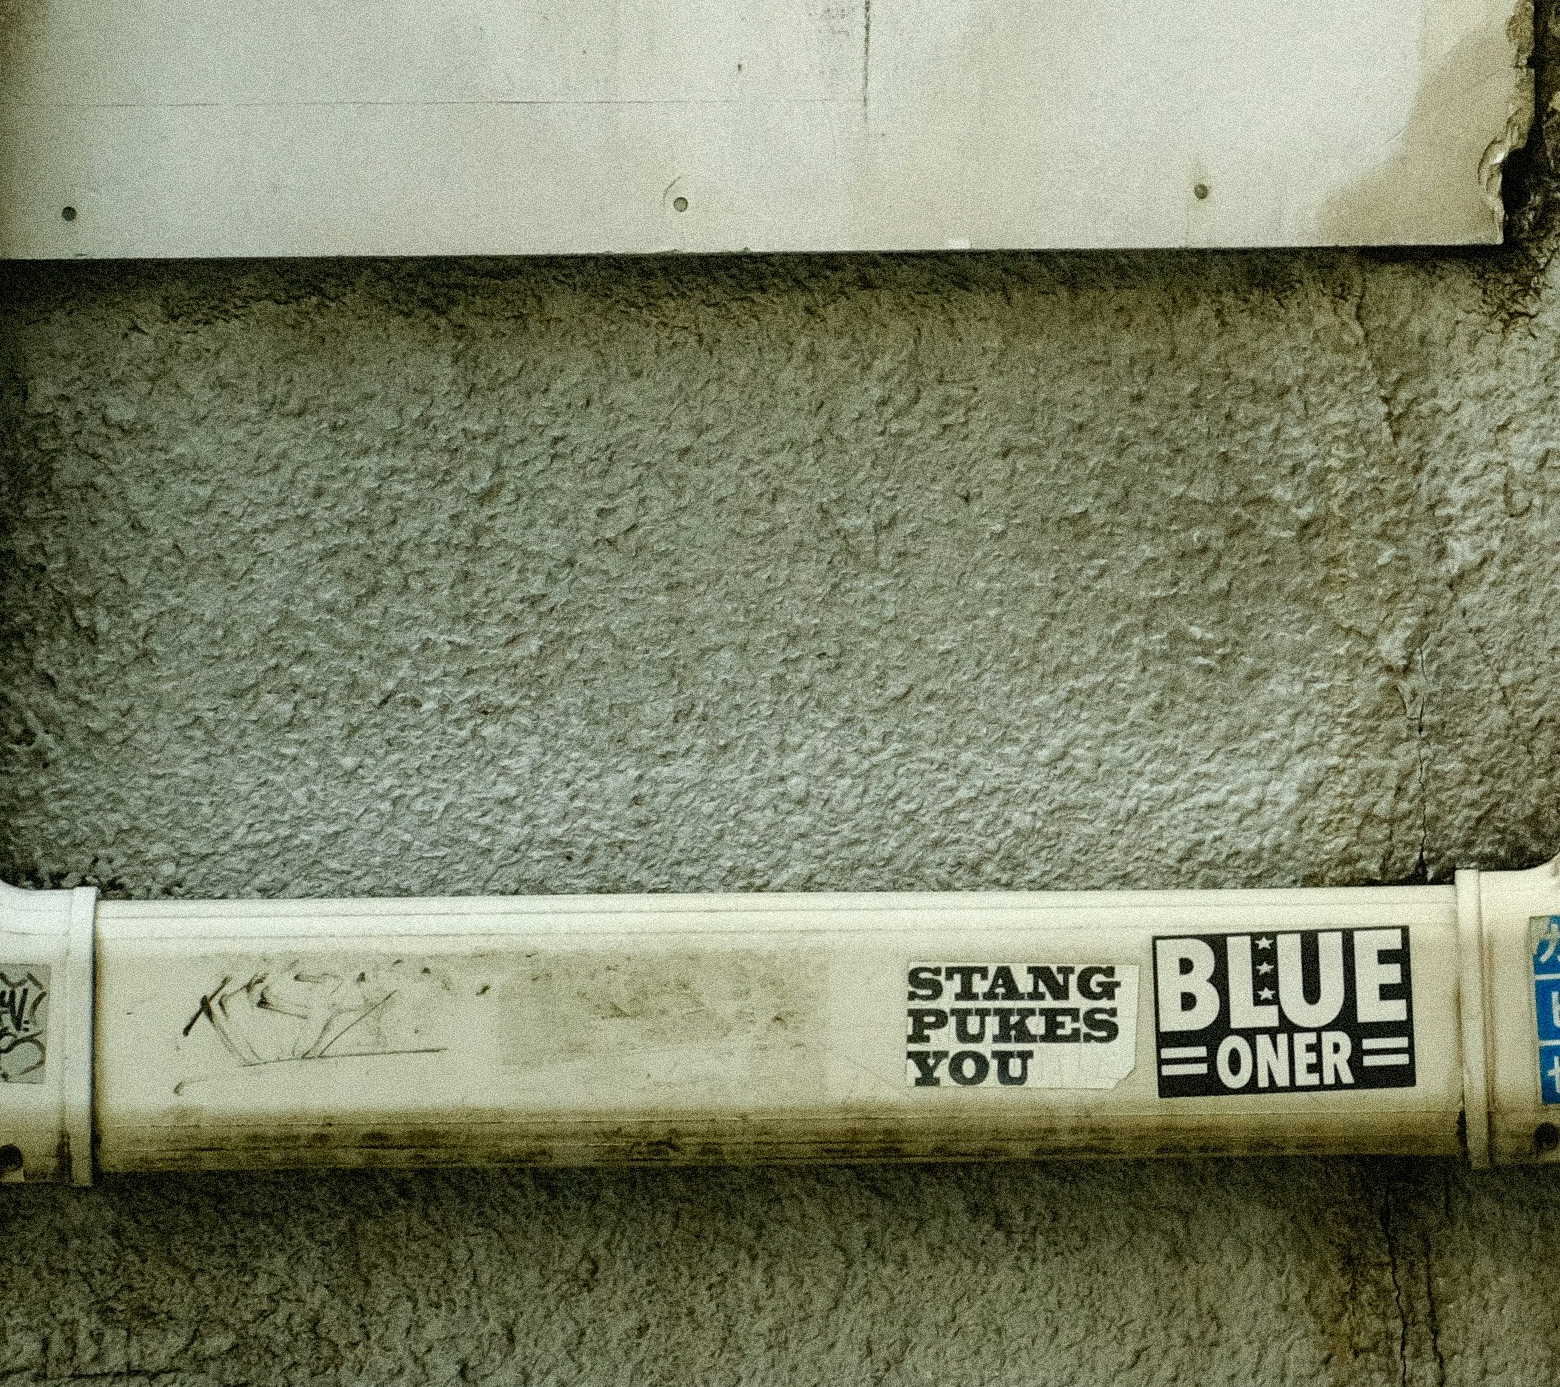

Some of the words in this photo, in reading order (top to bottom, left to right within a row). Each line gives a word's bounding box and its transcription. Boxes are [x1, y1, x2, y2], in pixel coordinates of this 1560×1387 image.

[907, 966, 1120, 1002] STANG
[1155, 927, 1408, 1033] BLUE
[907, 1007, 1120, 1044] PUKES
[907, 1049, 1035, 1087] YOU
[1216, 1030, 1355, 1090] ONER
